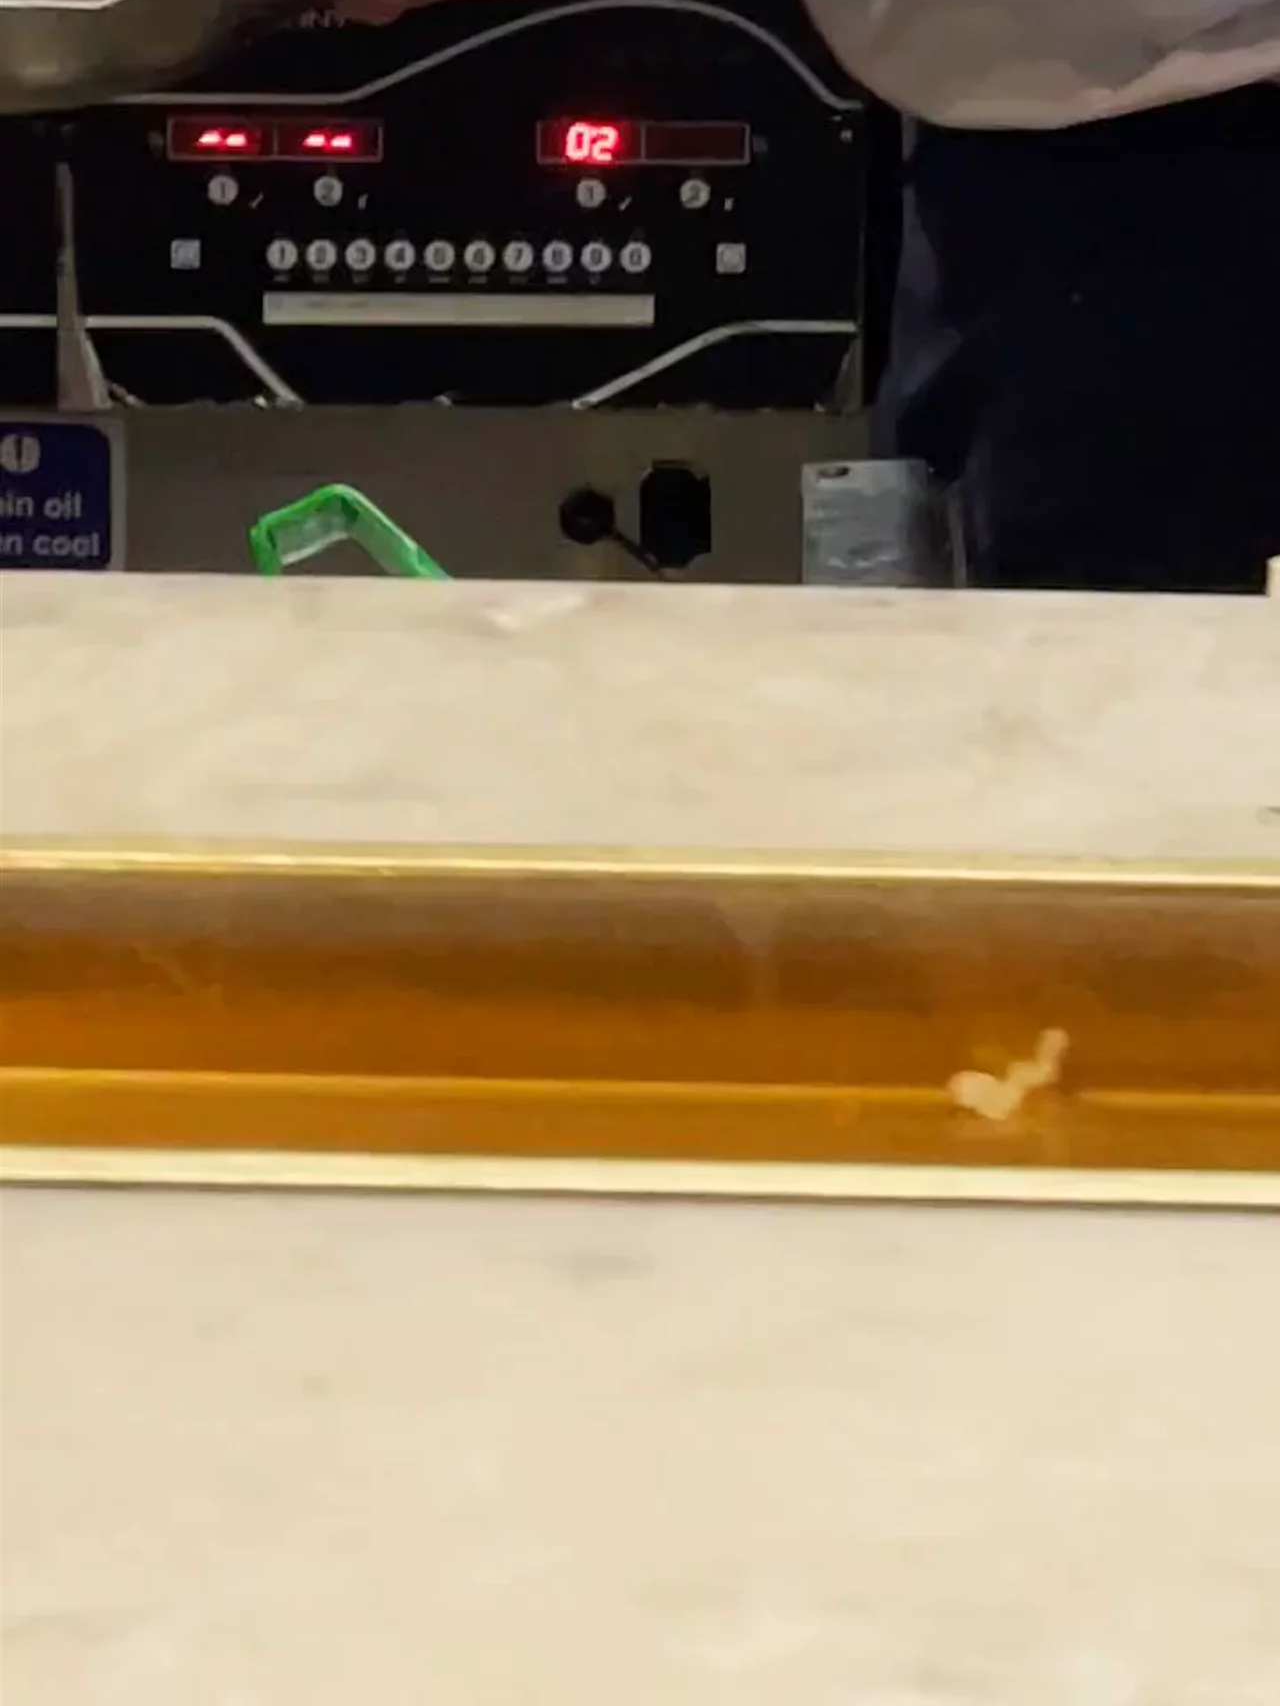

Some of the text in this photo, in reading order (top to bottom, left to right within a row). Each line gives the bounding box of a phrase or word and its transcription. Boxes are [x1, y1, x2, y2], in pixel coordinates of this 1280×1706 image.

[565, 122, 619, 162] 02
[43, 490, 82, 520] oil
[32, 532, 101, 558] cool
